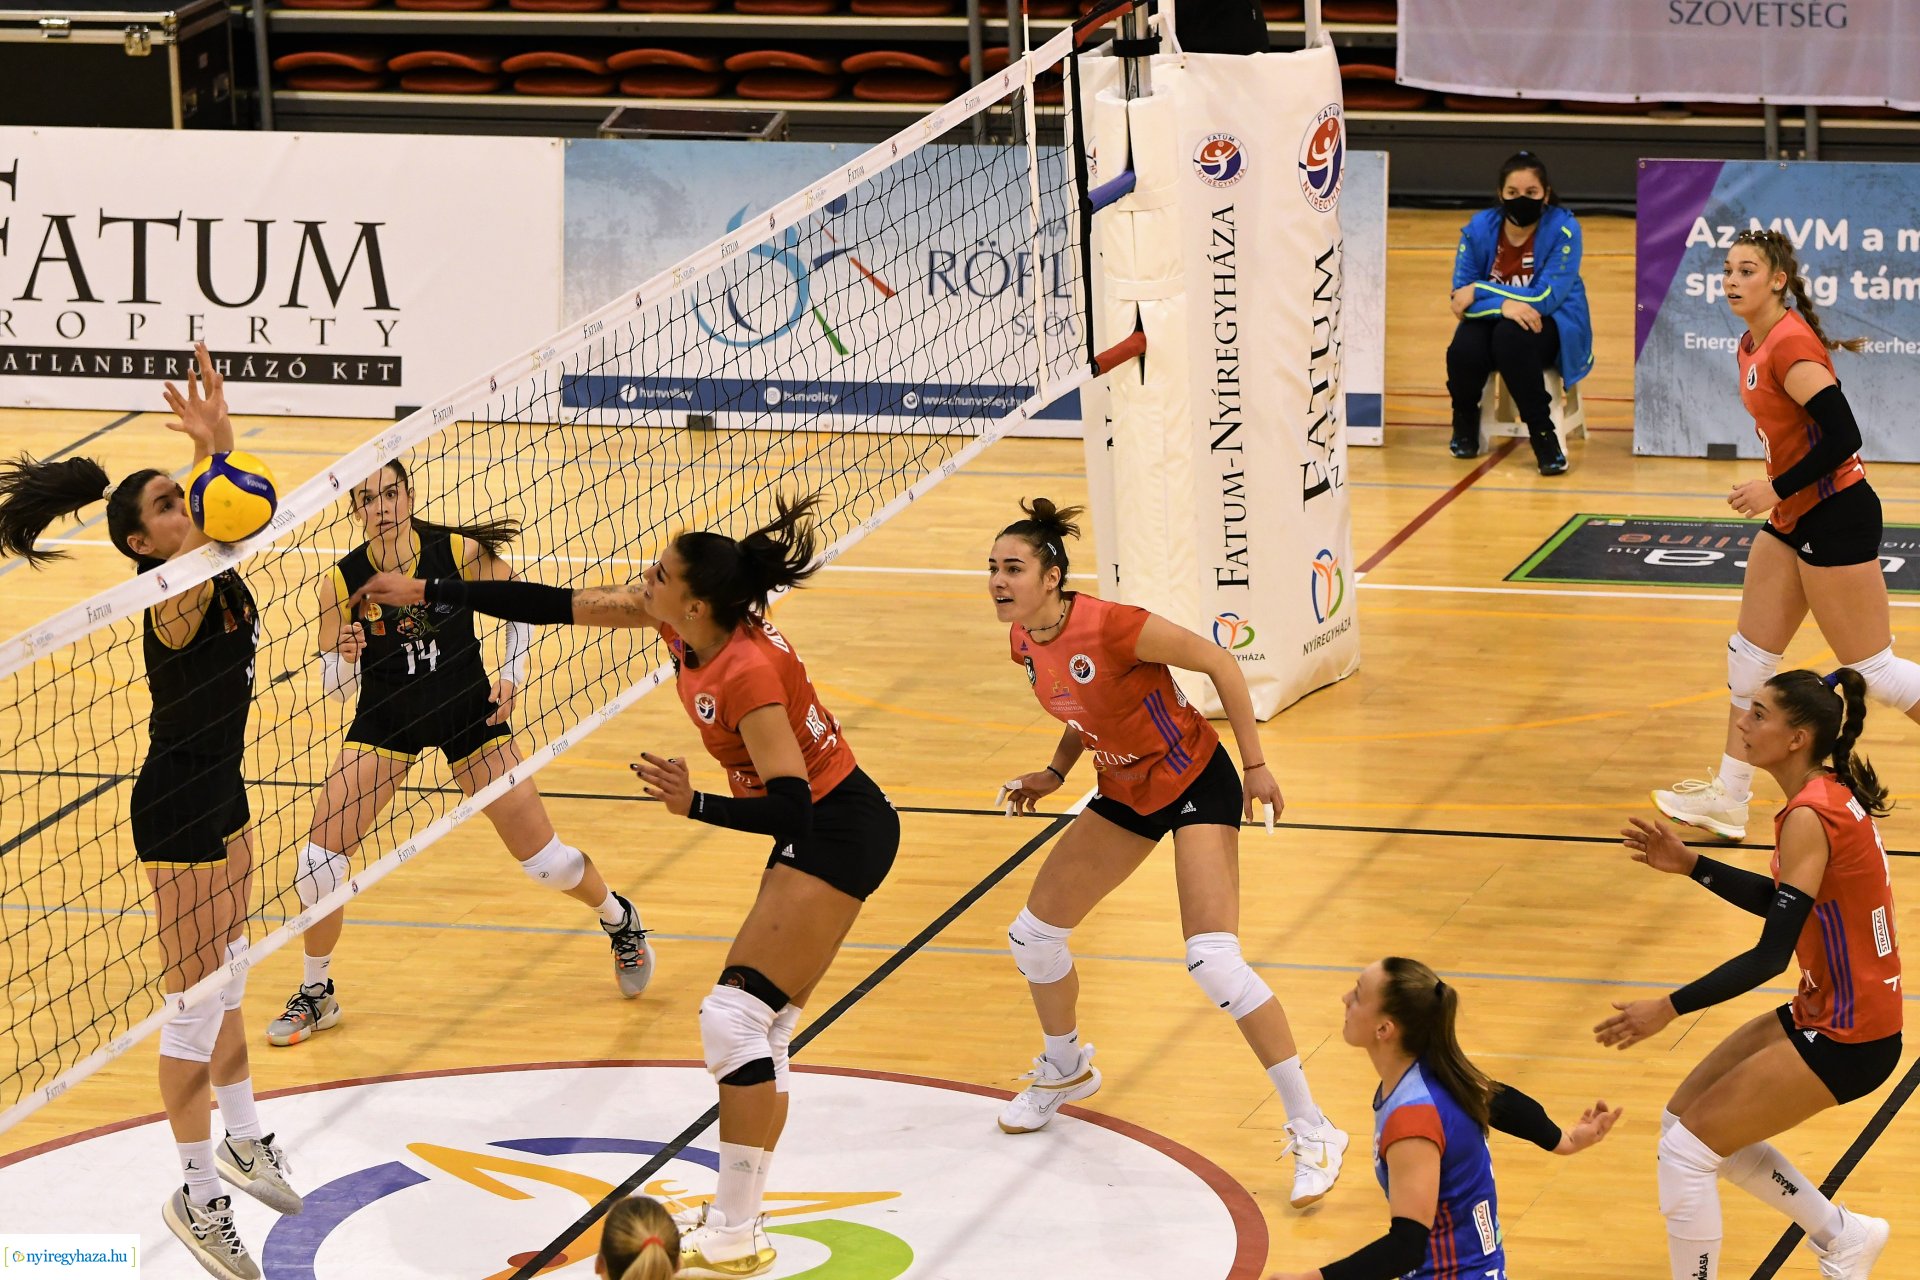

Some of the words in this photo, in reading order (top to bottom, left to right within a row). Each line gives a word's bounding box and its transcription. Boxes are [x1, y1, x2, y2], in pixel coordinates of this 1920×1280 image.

[1317, 106, 1341, 125] FATUM
[1207, 134, 1235, 143] FATUM
[0, 158, 400, 311] ATUM
[1685, 217, 1736, 249] Az
[1862, 229, 1883, 251] a
[332, 362, 394, 381] KFT
[86, 602, 112, 624] FATUM
[401, 639, 441, 675] 14
[230, 958, 250, 976] FATUM
[46, 1081, 67, 1101] FATUM
